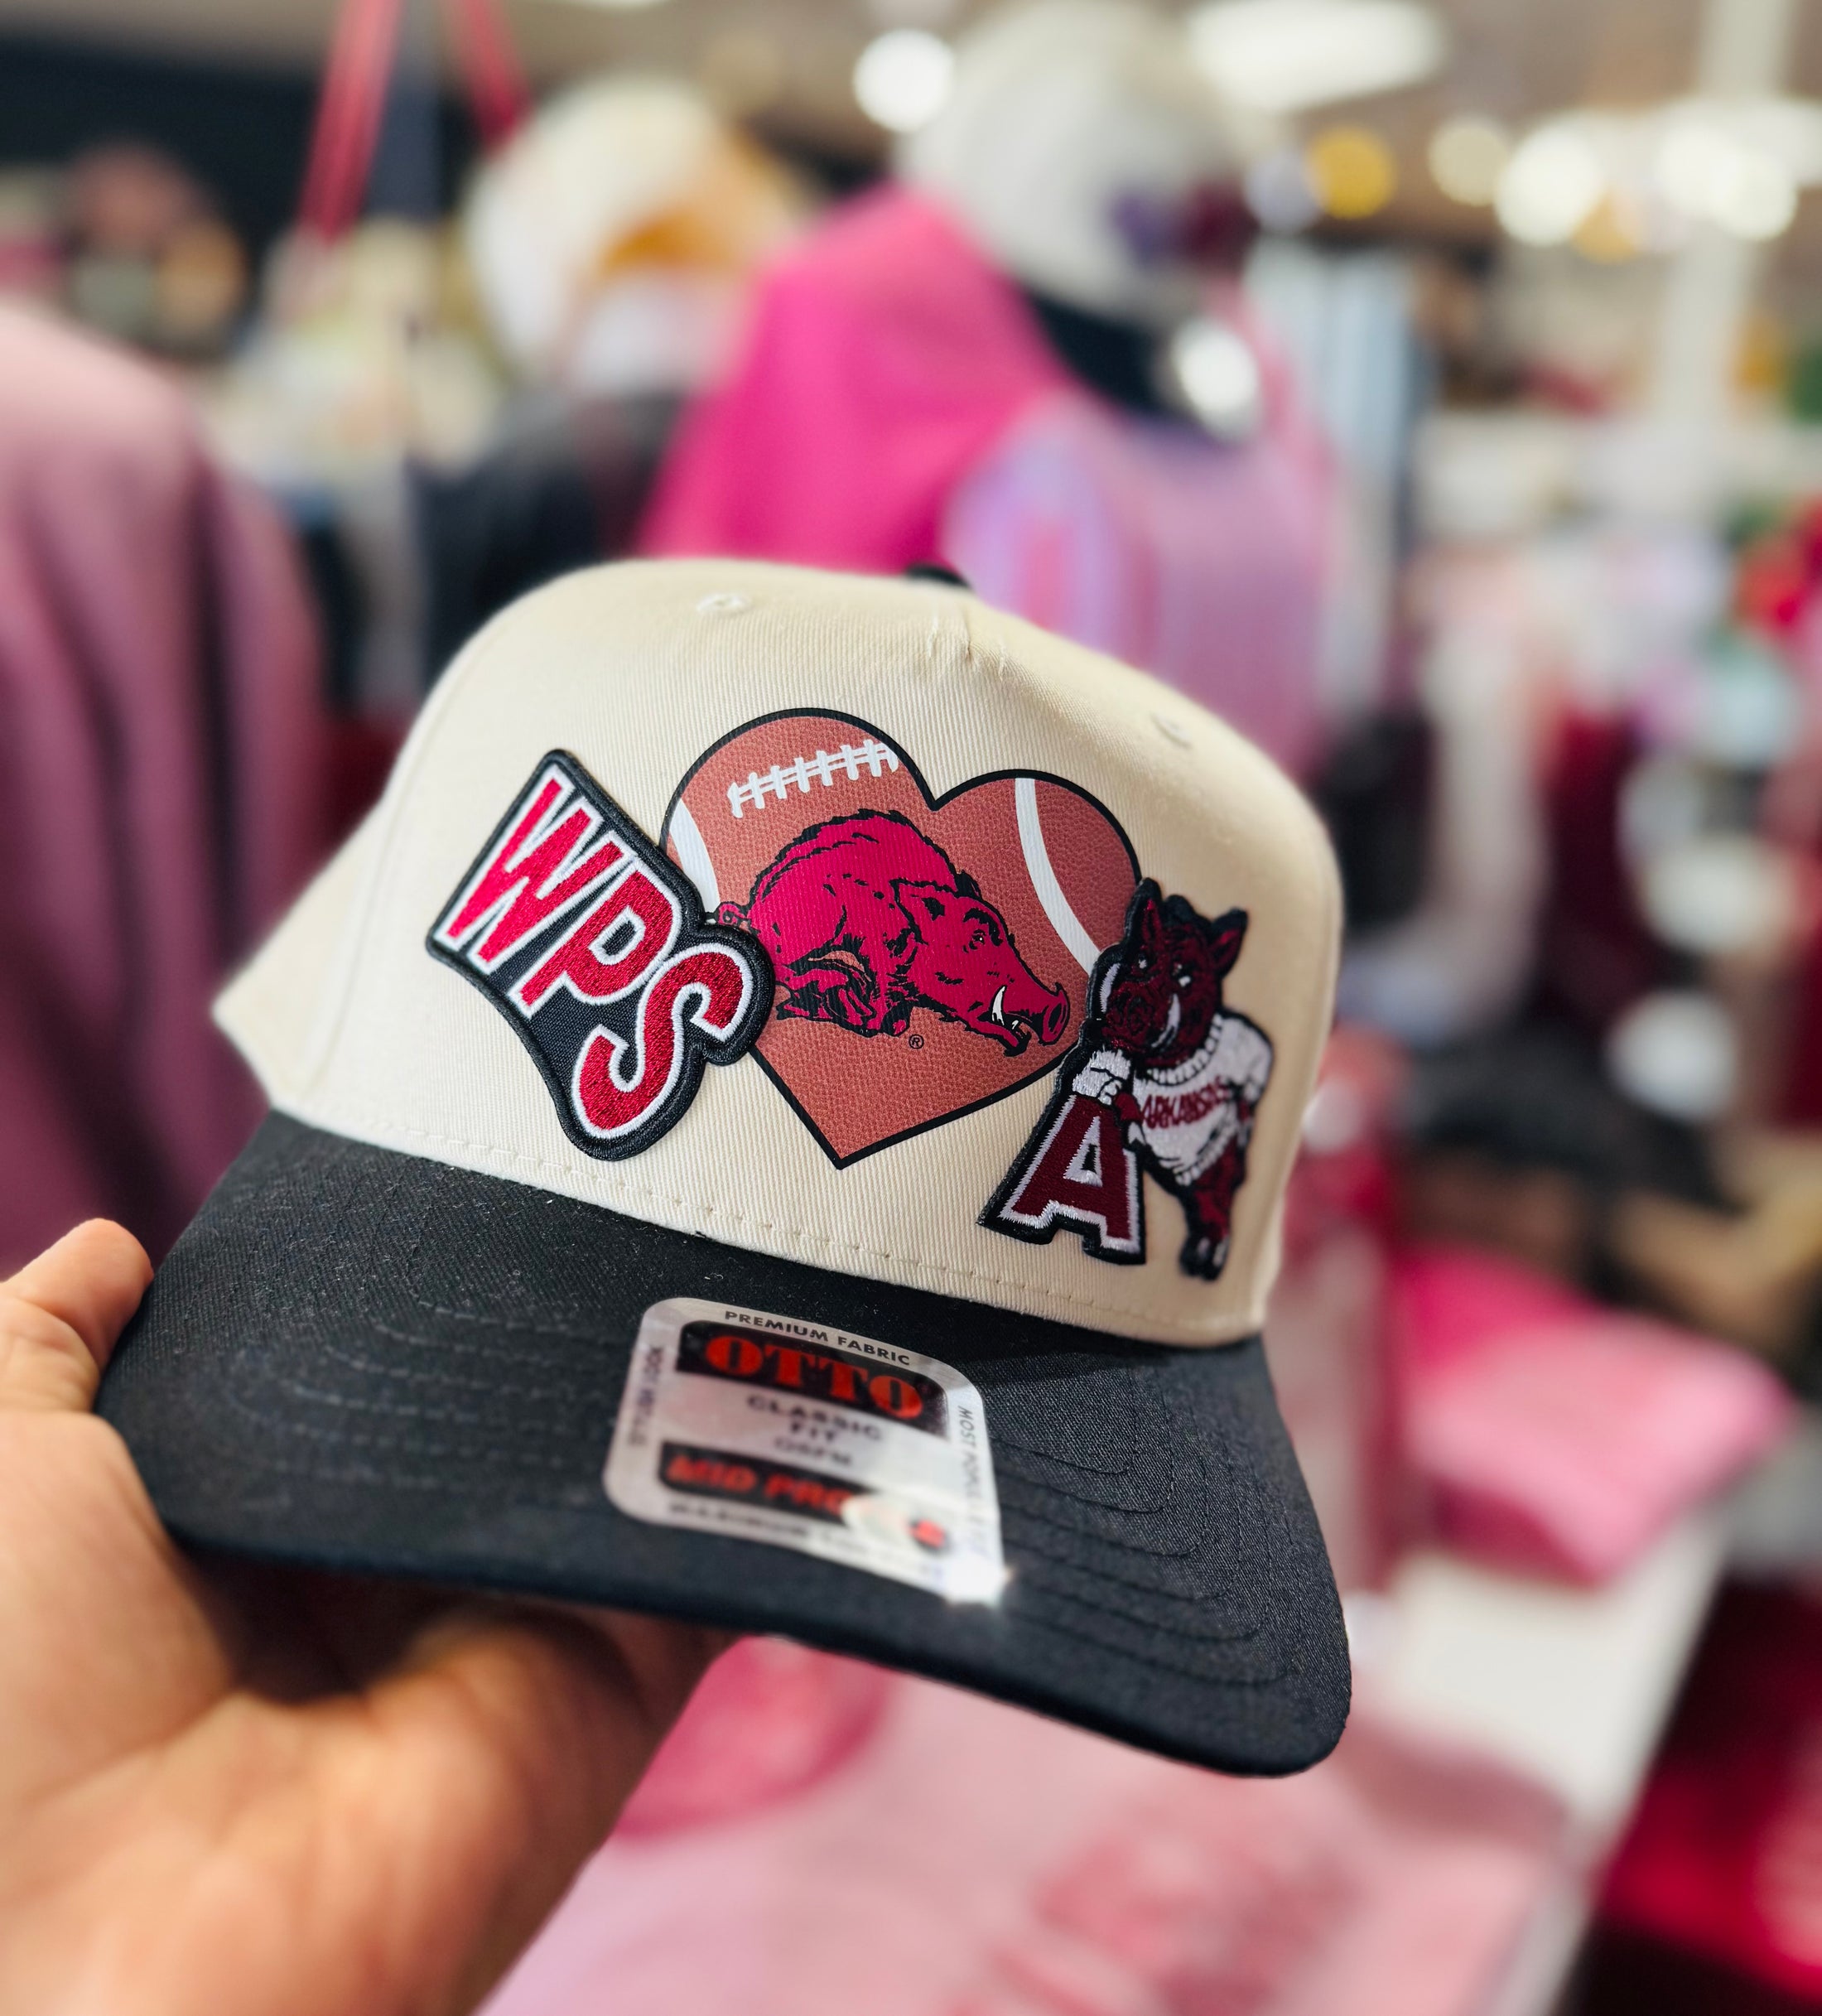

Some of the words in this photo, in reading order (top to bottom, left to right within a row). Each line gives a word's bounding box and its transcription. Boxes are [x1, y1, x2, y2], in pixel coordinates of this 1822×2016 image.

[436, 764, 754, 1140] WPS
[997, 1094, 1142, 1254] A
[724, 1309, 829, 1342] PREMIUM
[837, 1335, 910, 1366] FABRIC
[706, 1335, 923, 1420] OTTO
[747, 1394, 883, 1441] CLASSIC
[790, 1421, 837, 1441] FIT
[957, 1405, 977, 1448] MOST
